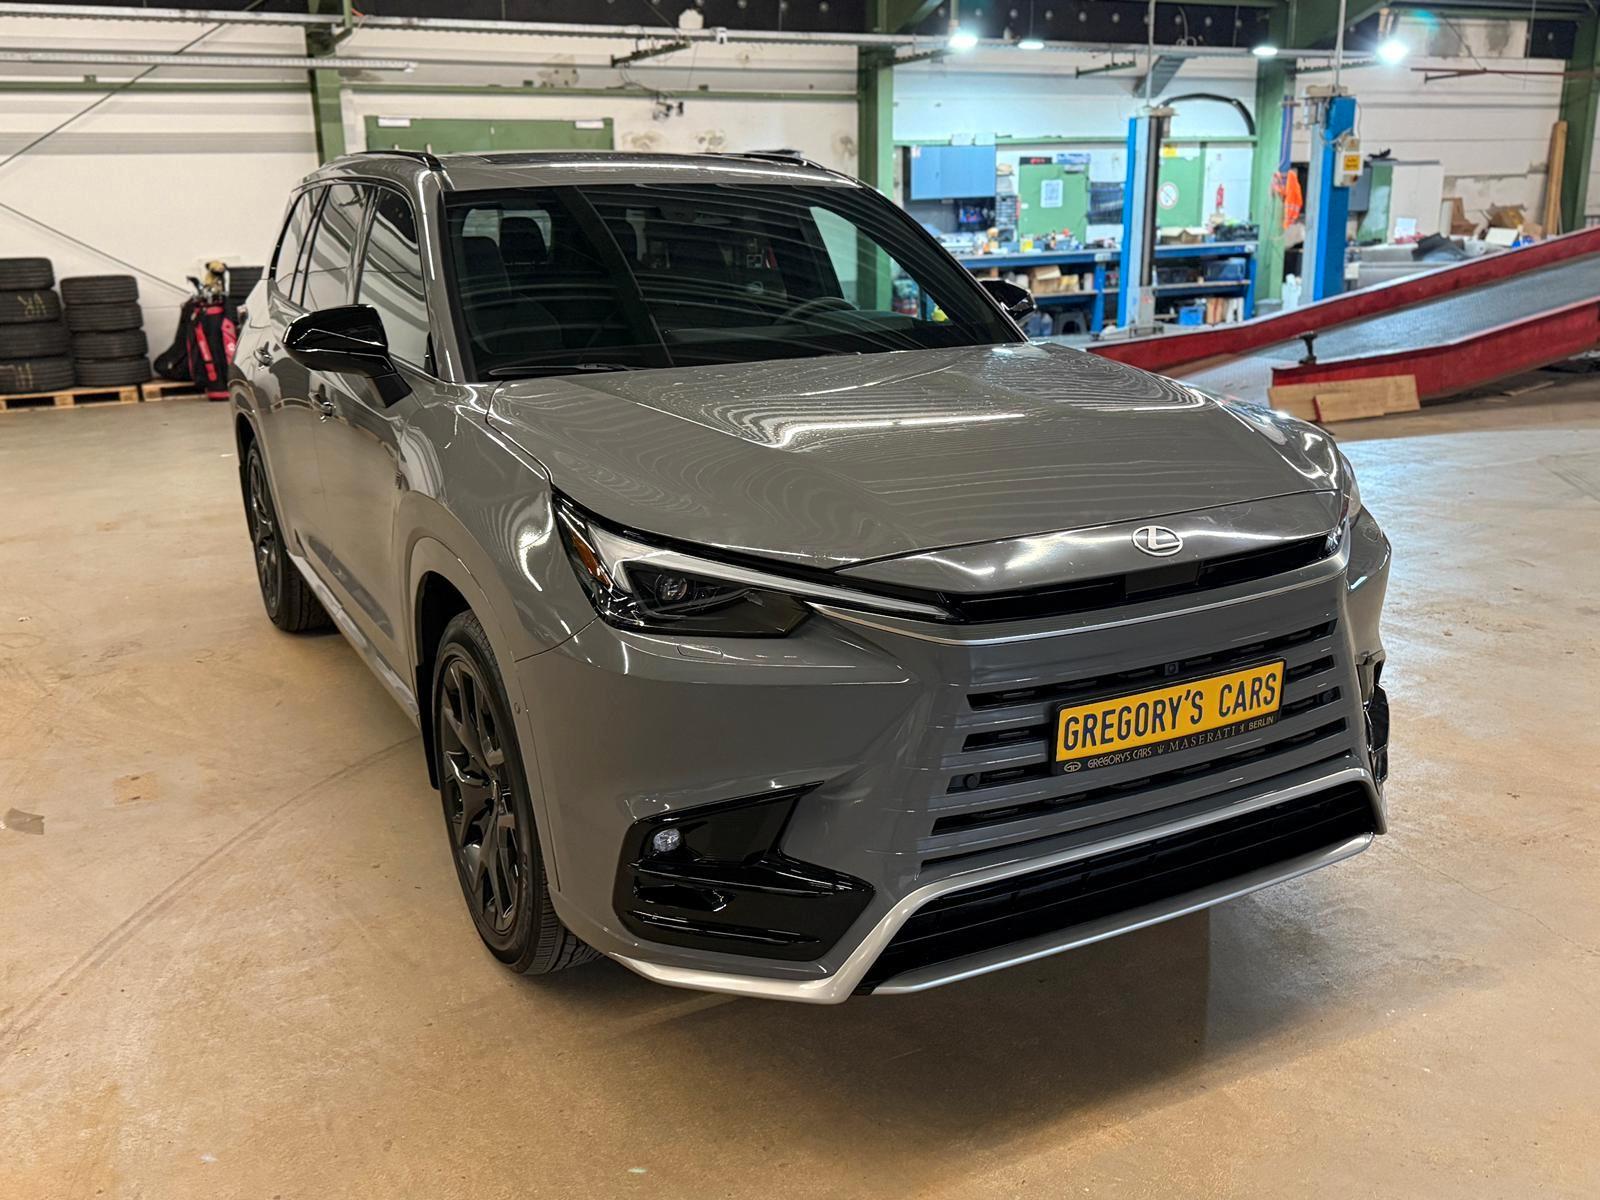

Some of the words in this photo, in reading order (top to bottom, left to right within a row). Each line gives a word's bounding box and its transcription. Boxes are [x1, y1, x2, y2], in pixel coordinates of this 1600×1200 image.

[1064, 689, 1204, 751] GREGORY'S
[1219, 672, 1277, 717] CARS
[1132, 747, 1152, 759] CARS
[1169, 726, 1236, 752] MASERATI
[1248, 716, 1274, 729] BERLIN
